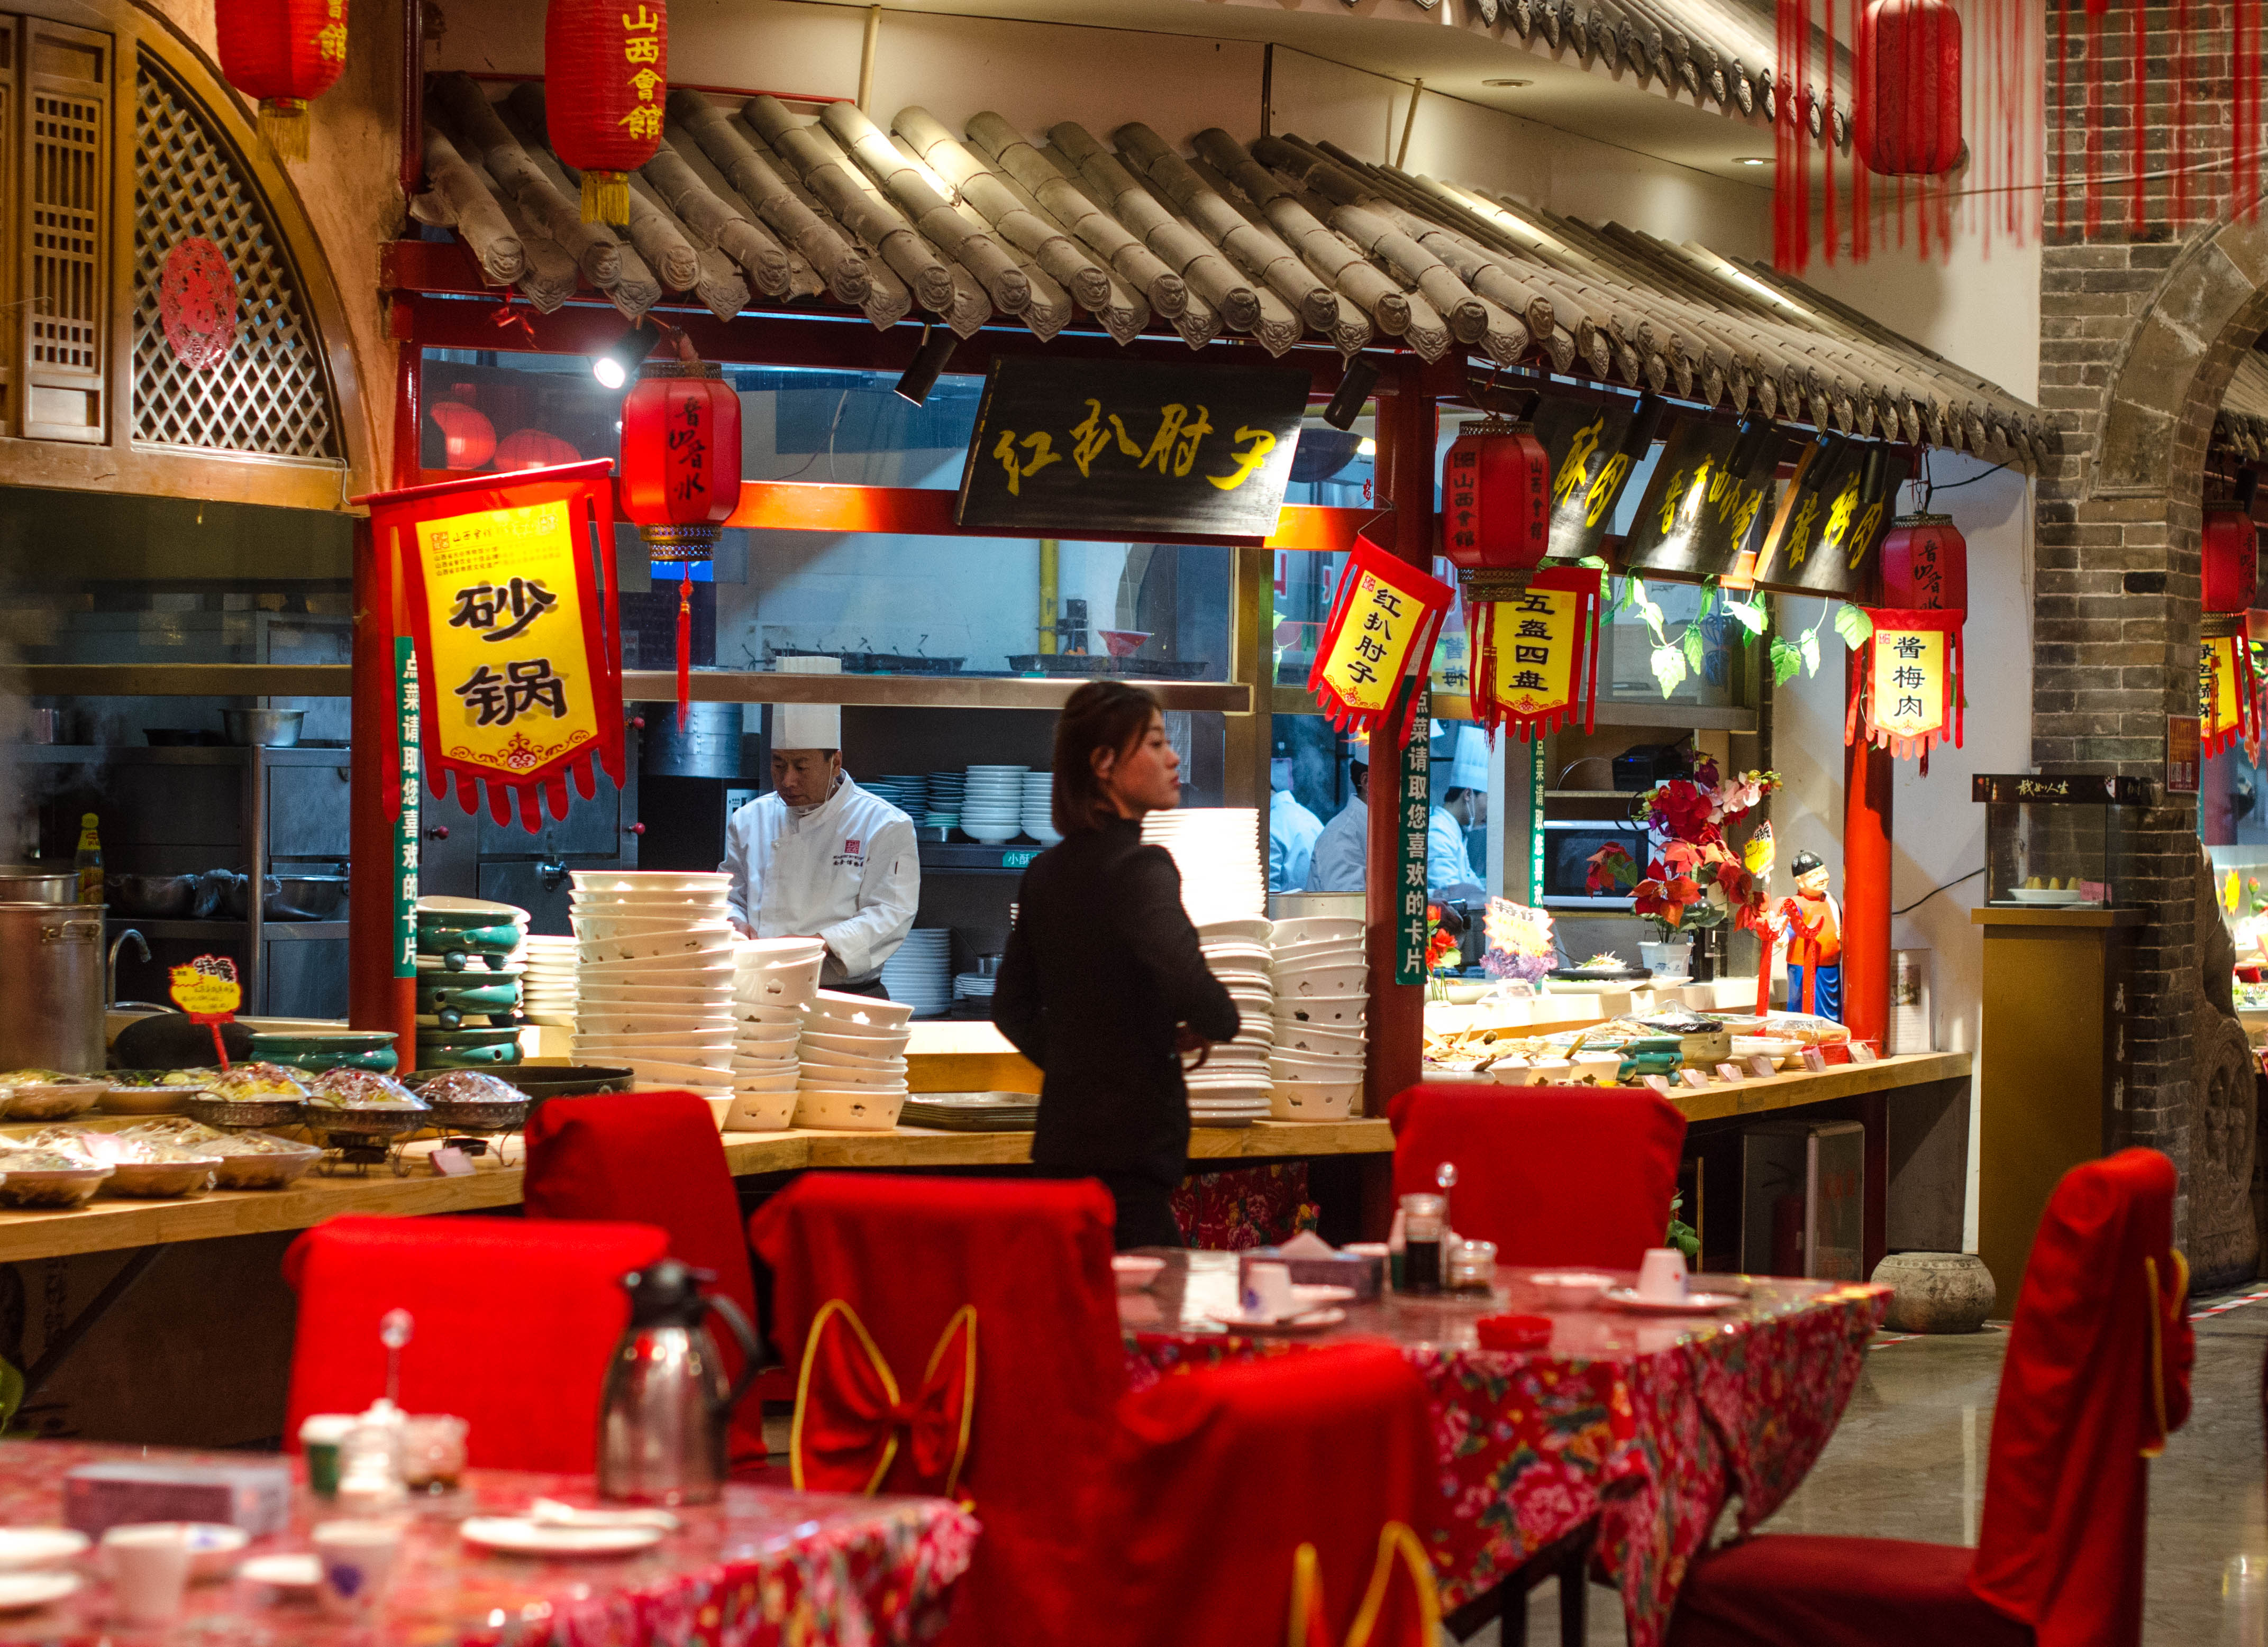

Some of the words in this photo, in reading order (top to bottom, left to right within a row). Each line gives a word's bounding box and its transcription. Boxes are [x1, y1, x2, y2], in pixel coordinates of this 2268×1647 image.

[618, 4, 663, 140] 山西會館
[449, 577, 568, 726] 砂锅
[1346, 588, 1402, 684] 红扒肘子
[1508, 593, 1556, 692] 五盔四盘
[1892, 636, 1926, 718] 酱梅肉
[402, 651, 418, 966] 点菜请取您喜欢的卡片
[1008, 853, 1037, 866] 小酥
[1404, 689, 1428, 975] 点菜请取您喜欢的卡片
